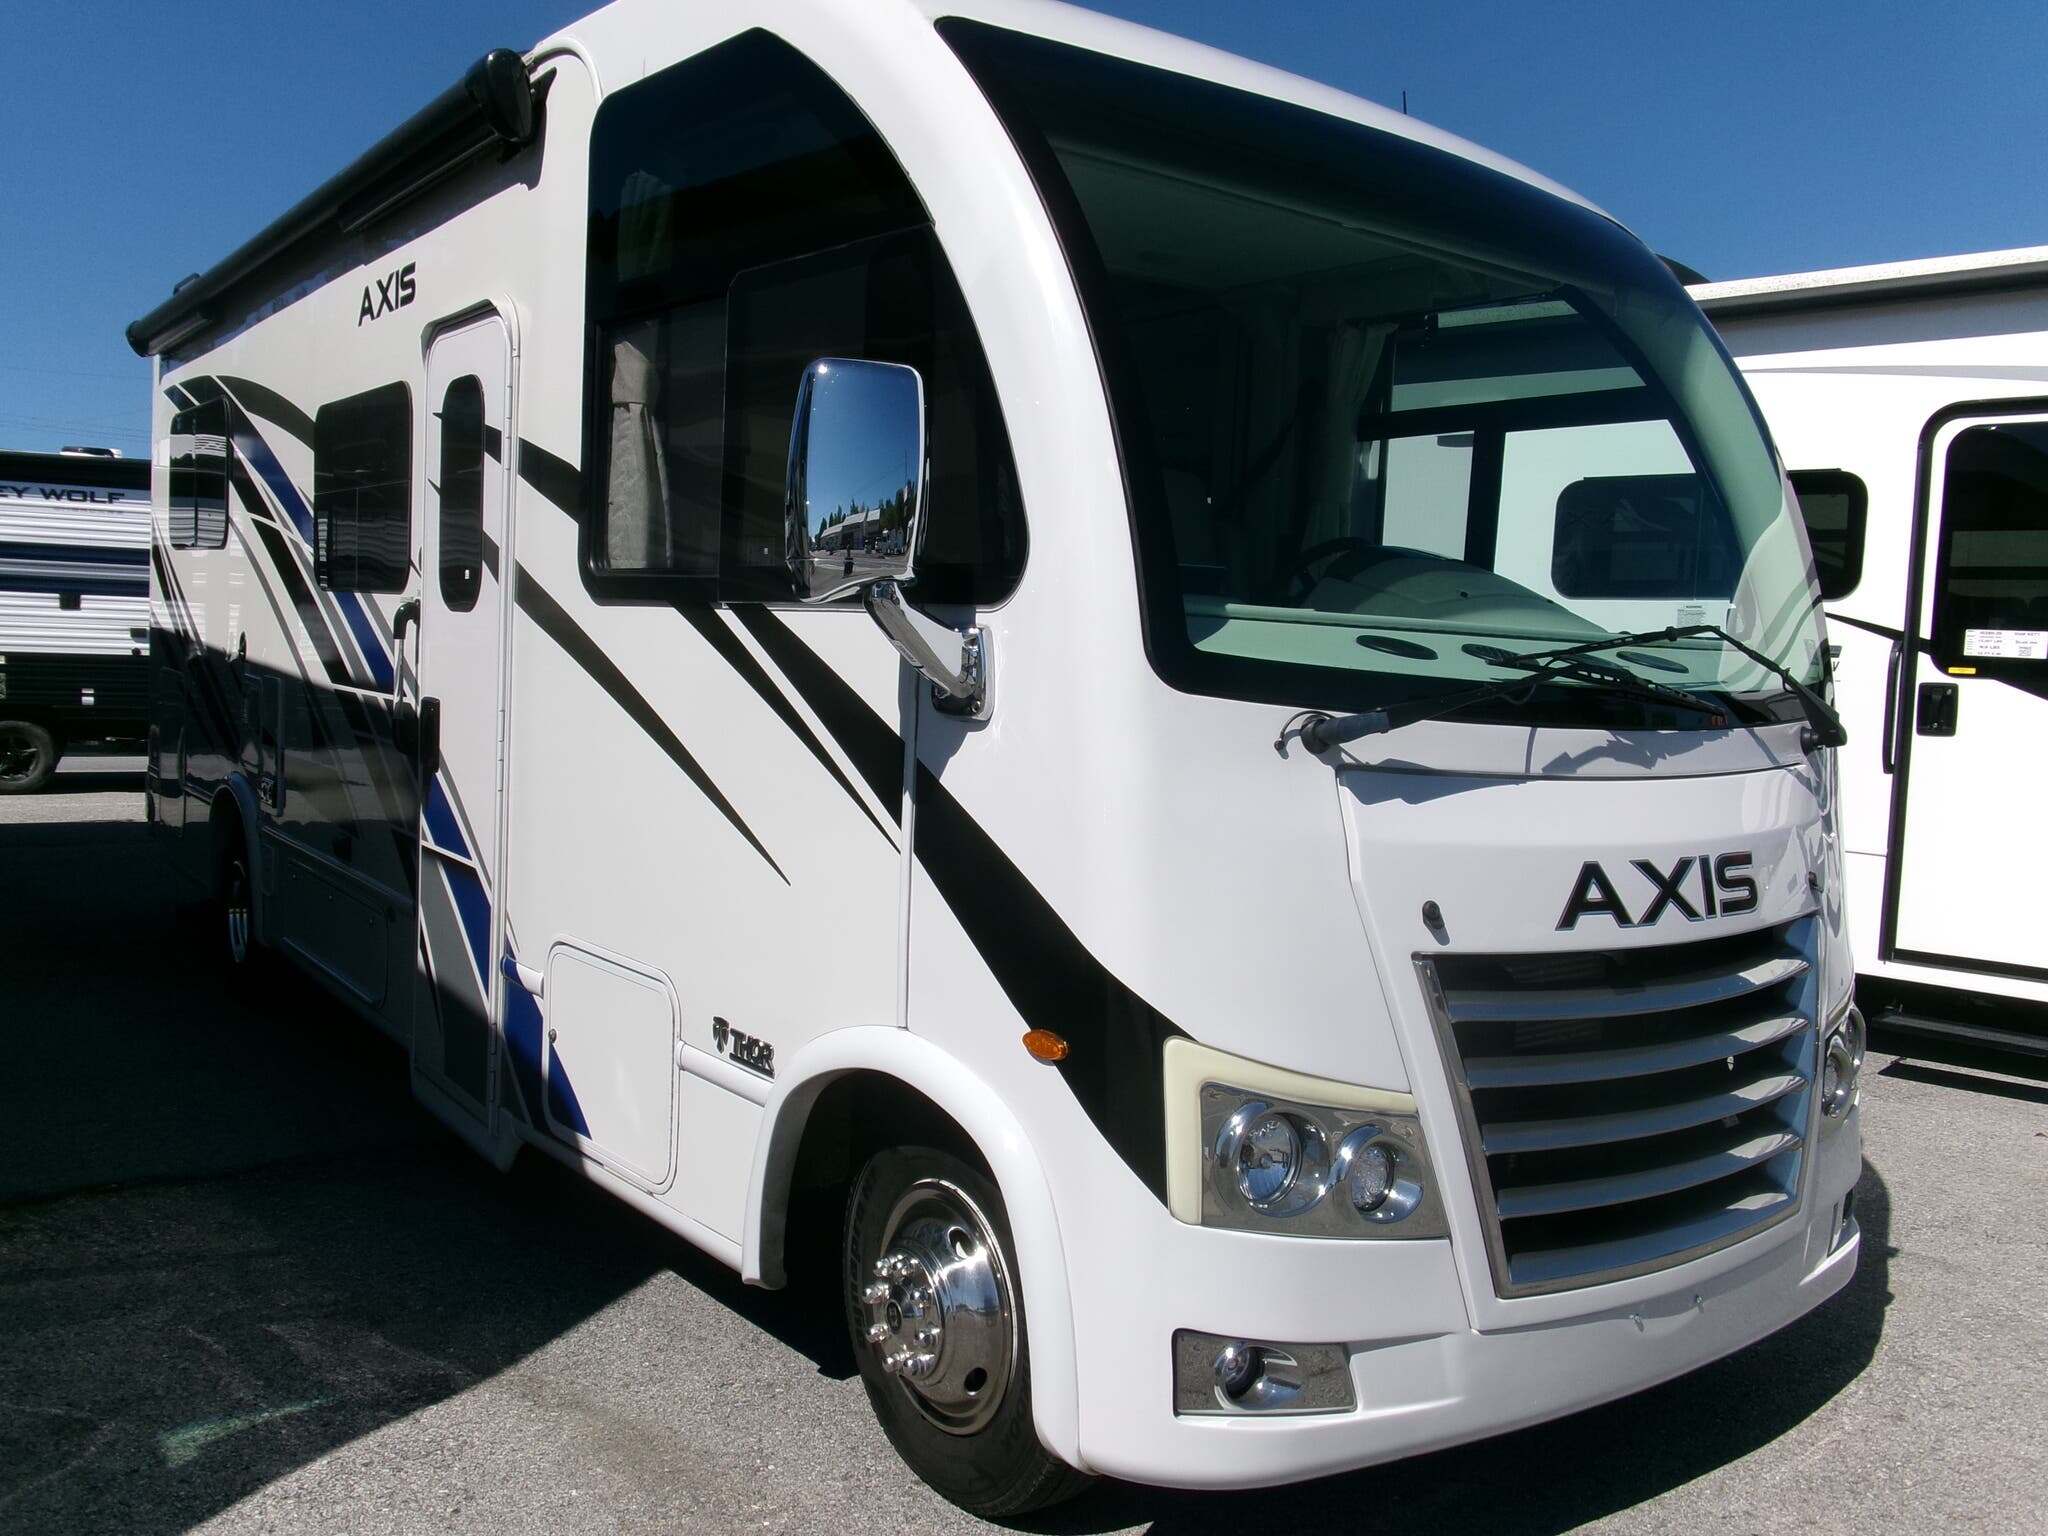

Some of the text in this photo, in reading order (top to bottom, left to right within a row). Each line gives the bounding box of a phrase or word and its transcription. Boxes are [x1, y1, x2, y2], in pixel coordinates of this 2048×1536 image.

[358, 261, 416, 328] AXIS
[39, 487, 125, 504] WOLF
[1555, 850, 1759, 931] AXIS
[729, 1027, 775, 1077] THOR
